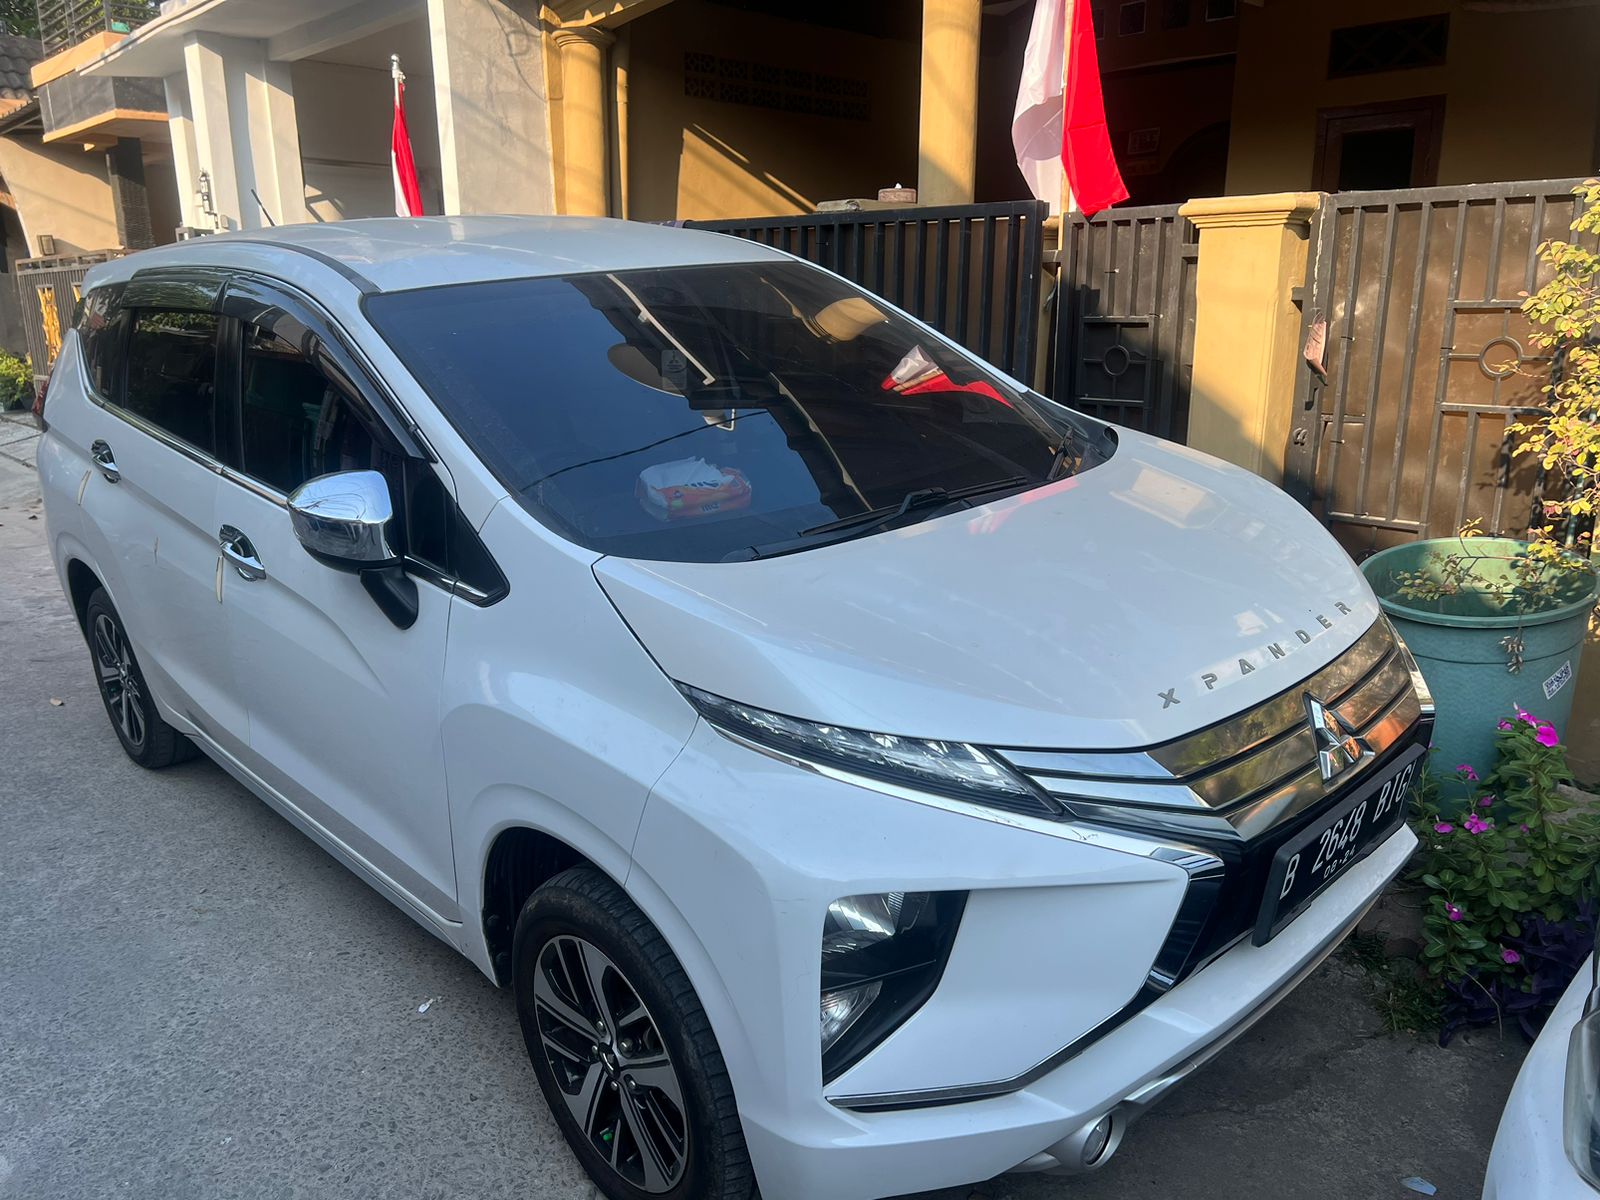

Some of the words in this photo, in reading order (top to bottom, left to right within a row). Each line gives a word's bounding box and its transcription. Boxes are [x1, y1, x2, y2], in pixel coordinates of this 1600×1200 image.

[1157, 601, 1353, 709] XPANDER
[1279, 853, 1300, 900] B
[1311, 800, 1368, 874] 2648
[1372, 763, 1413, 823] BIG
